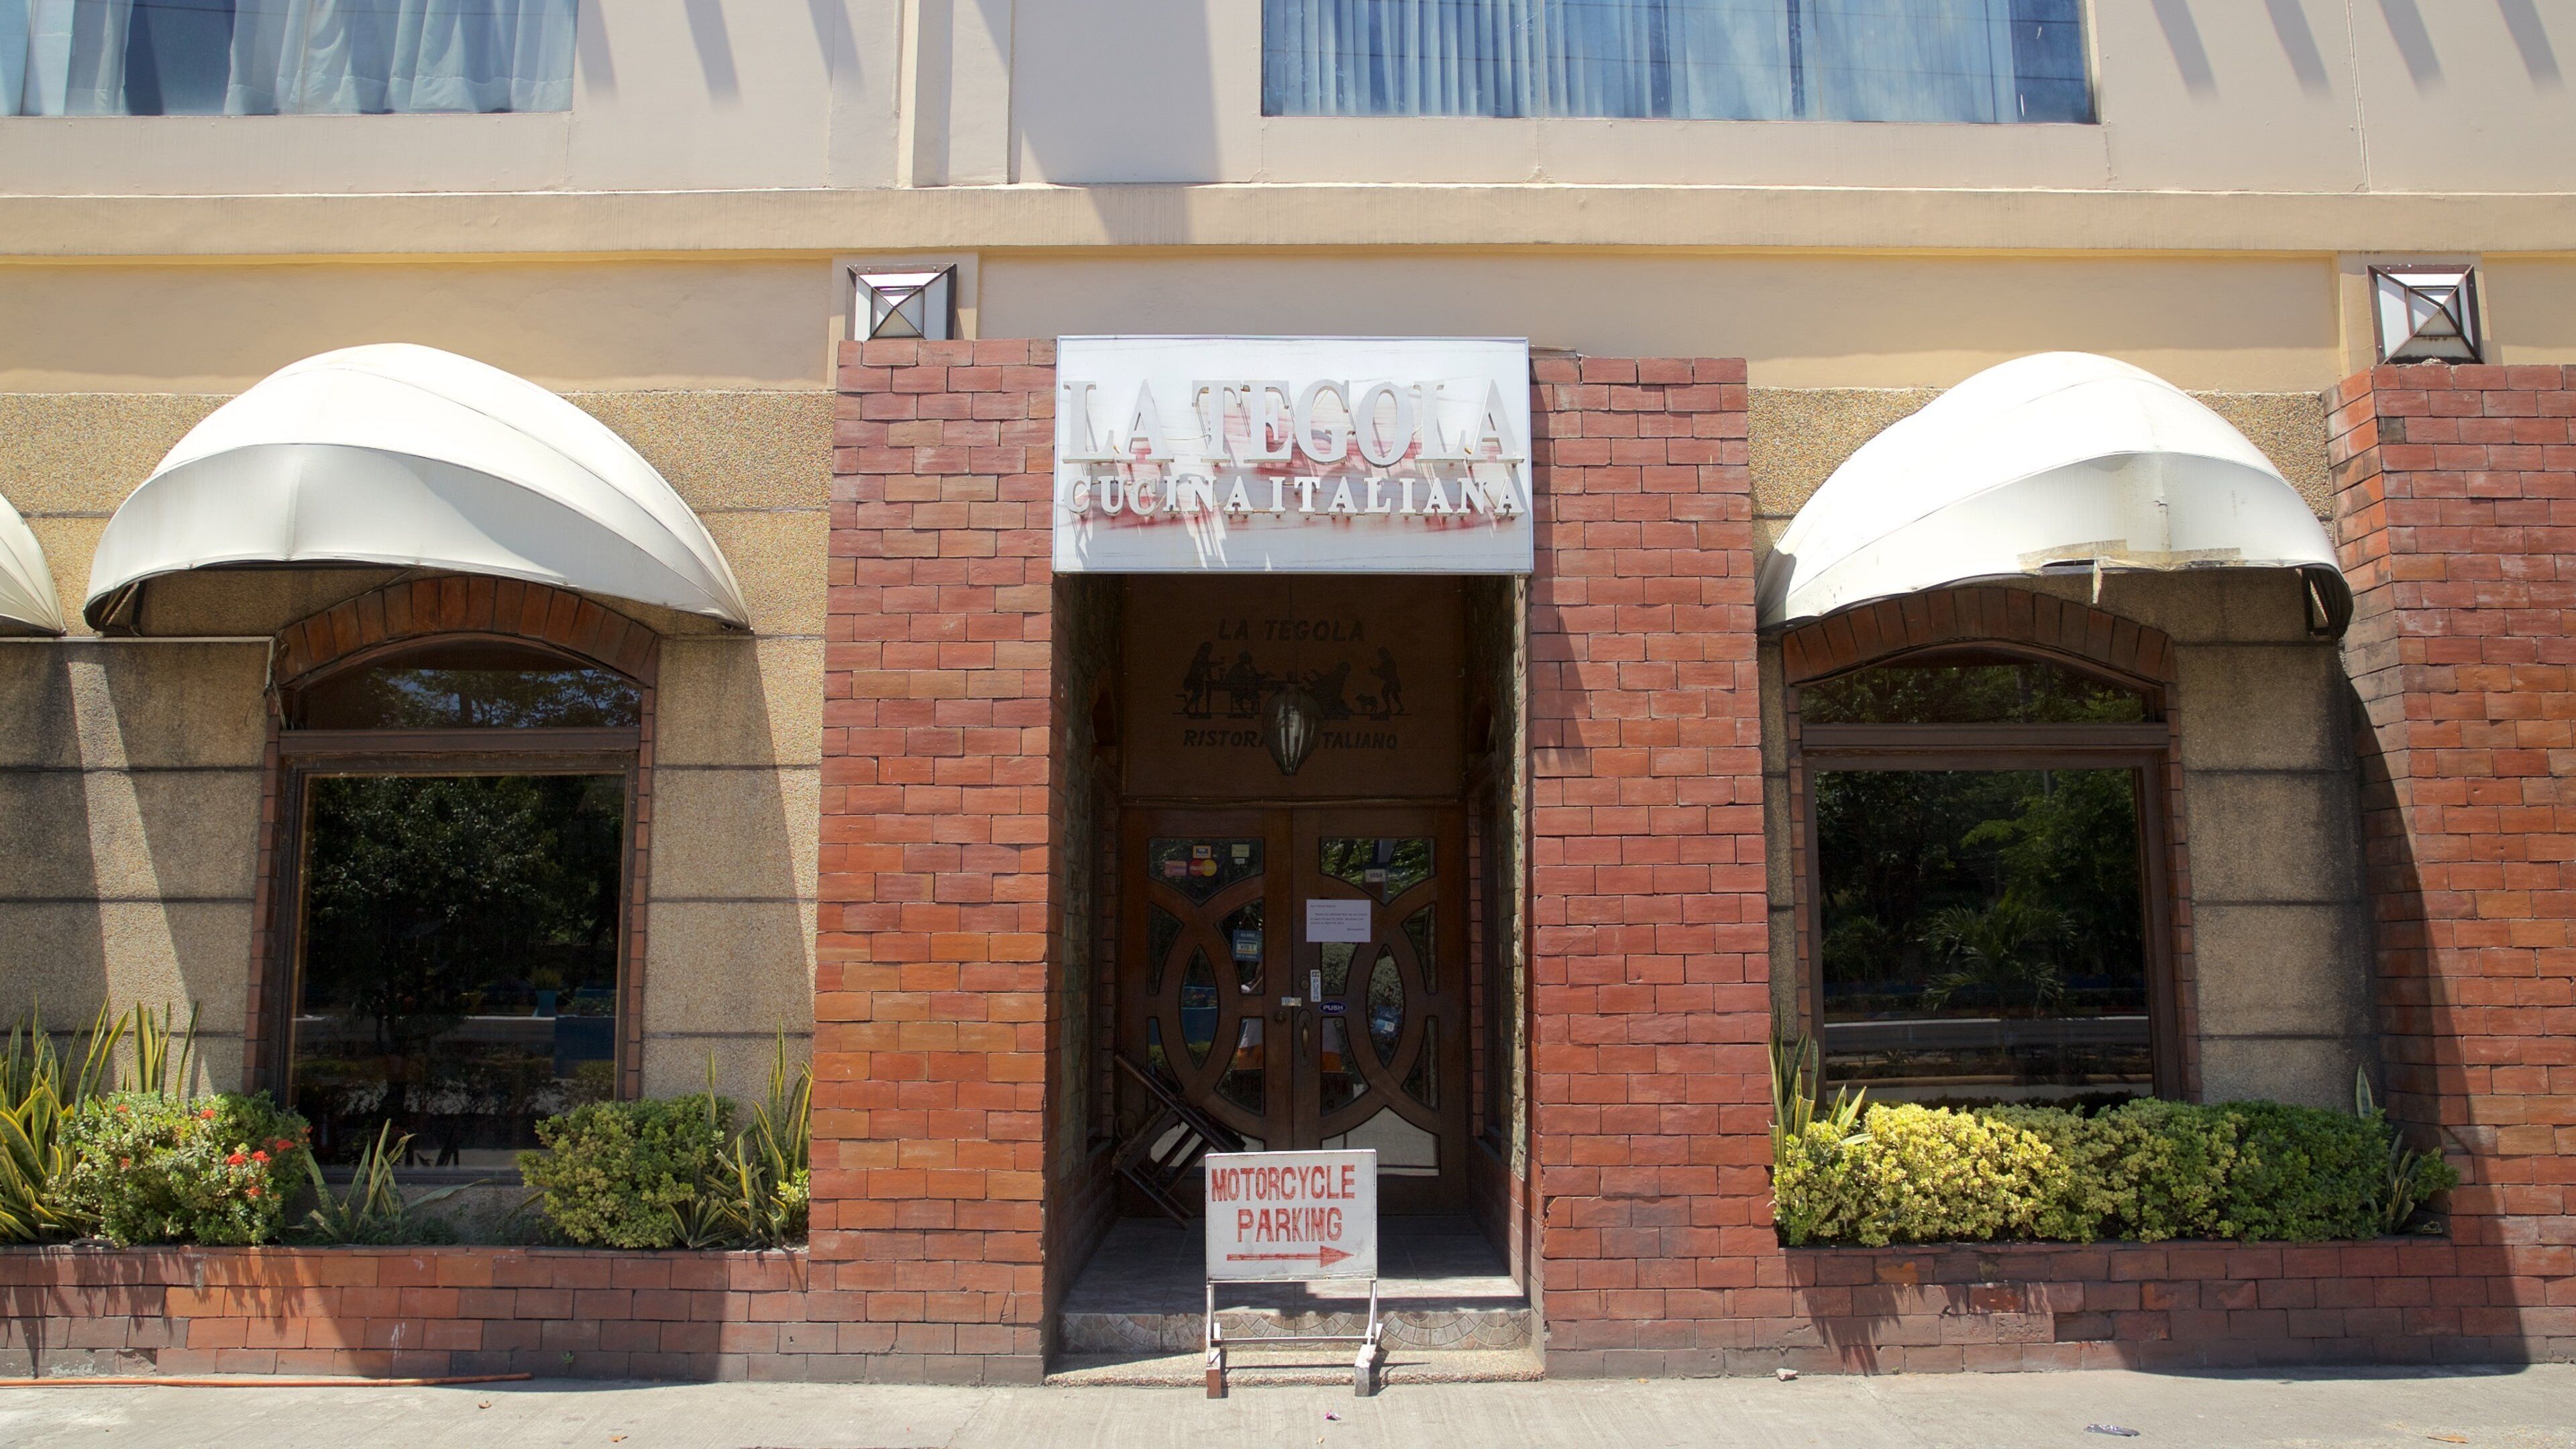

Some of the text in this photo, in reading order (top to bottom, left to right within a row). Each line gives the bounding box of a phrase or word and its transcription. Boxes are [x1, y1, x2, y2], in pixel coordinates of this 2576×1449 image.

[1063, 378, 1525, 468] LA TEGOLA
[1063, 474, 1525, 516] CUCINA ITALIANA
[1217, 619, 1365, 642] LA TEGOLA
[1212, 1165, 1355, 1201] MOTORCYCLE
[1238, 1207, 1342, 1242] PARKING
